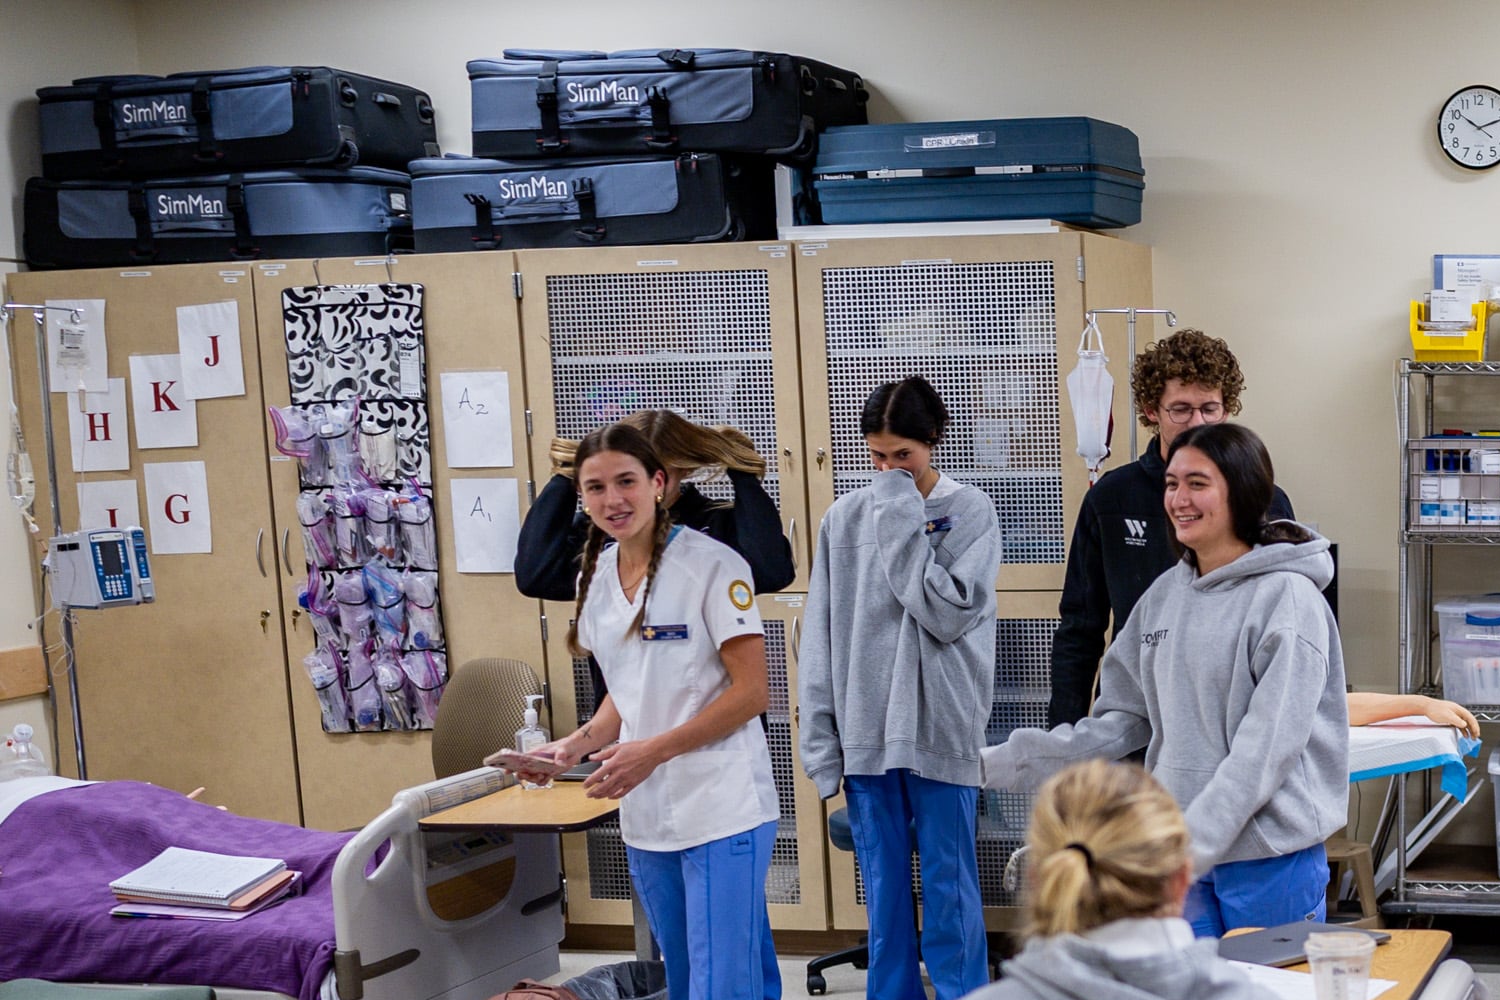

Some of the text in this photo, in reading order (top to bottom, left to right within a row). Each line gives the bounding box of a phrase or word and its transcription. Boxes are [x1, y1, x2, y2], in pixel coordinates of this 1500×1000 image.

[567, 81, 639, 103] SimMan
[1473, 94, 1484, 106] 12
[122, 100, 187, 124] SimMan
[1460, 97, 1469, 110] 11
[1451, 109, 1461, 120] 10
[1447, 122, 1455, 134] 9
[1452, 136, 1459, 148] 8
[1462, 147, 1470, 158] 7
[1475, 150, 1483, 161] 6
[1489, 146, 1497, 158] 5
[500, 176, 568, 199] SimMan
[158, 194, 223, 215] SimMan
[204, 334, 221, 367] J
[151, 380, 181, 412] K
[86, 412, 112, 442] H
[164, 493, 191, 525] G
